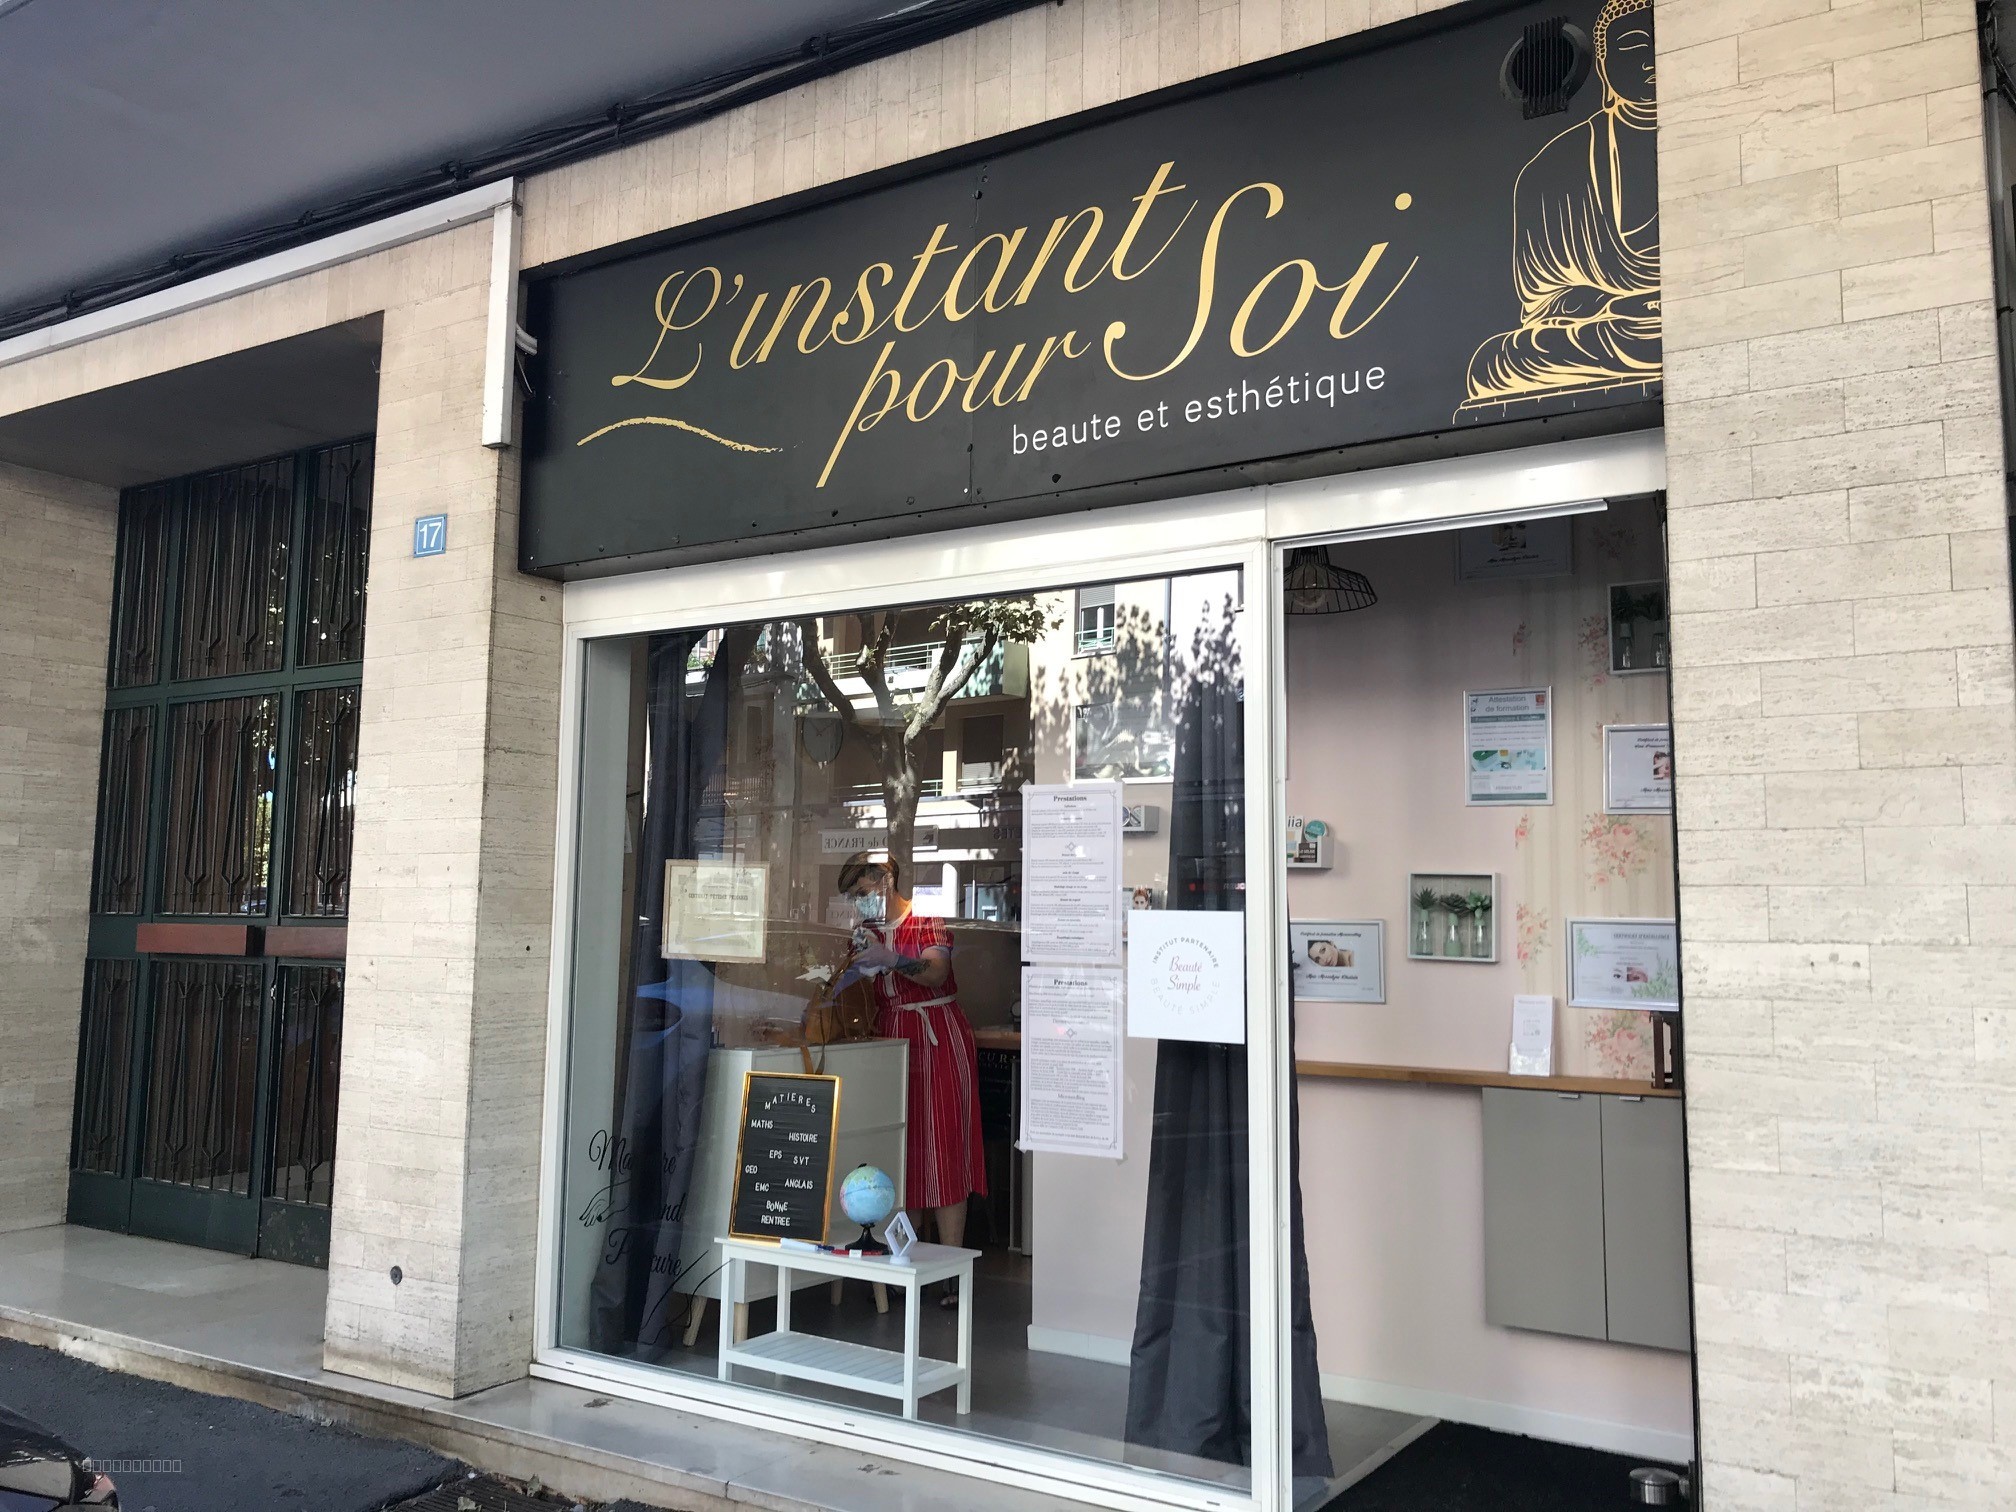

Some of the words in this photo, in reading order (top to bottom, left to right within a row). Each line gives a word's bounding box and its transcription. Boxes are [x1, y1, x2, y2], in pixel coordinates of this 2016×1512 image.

[611, 161, 1199, 391] L'instant
[816, 330, 1090, 488] pour
[1103, 182, 1420, 383] Soi
[1013, 423, 1122, 455] beaute
[1137, 401, 1169, 432] et
[1184, 366, 1386, 423] esthétique
[419, 521, 442, 549] 17
[1496, 704, 1530, 712] formation
[1053, 794, 1088, 802] Prestations
[1152, 937, 1178, 965] INSTITUT
[1180, 936, 1219, 968] PARTENAIRE
[1166, 973, 1201, 994] Simple
[764, 1092, 816, 1113] MATIERES
[751, 1119, 774, 1130] MATHS
[788, 1132, 818, 1143] HISTOIRE
[769, 1149, 783, 1160] EPS
[793, 1155, 810, 1166] SVT
[745, 1164, 758, 1175] GEO
[755, 1181, 770, 1192] EMC
[784, 1177, 814, 1190] ANGLAIS
[765, 1200, 789, 1213] BONNE
[760, 1214, 791, 1227] RENTREE
